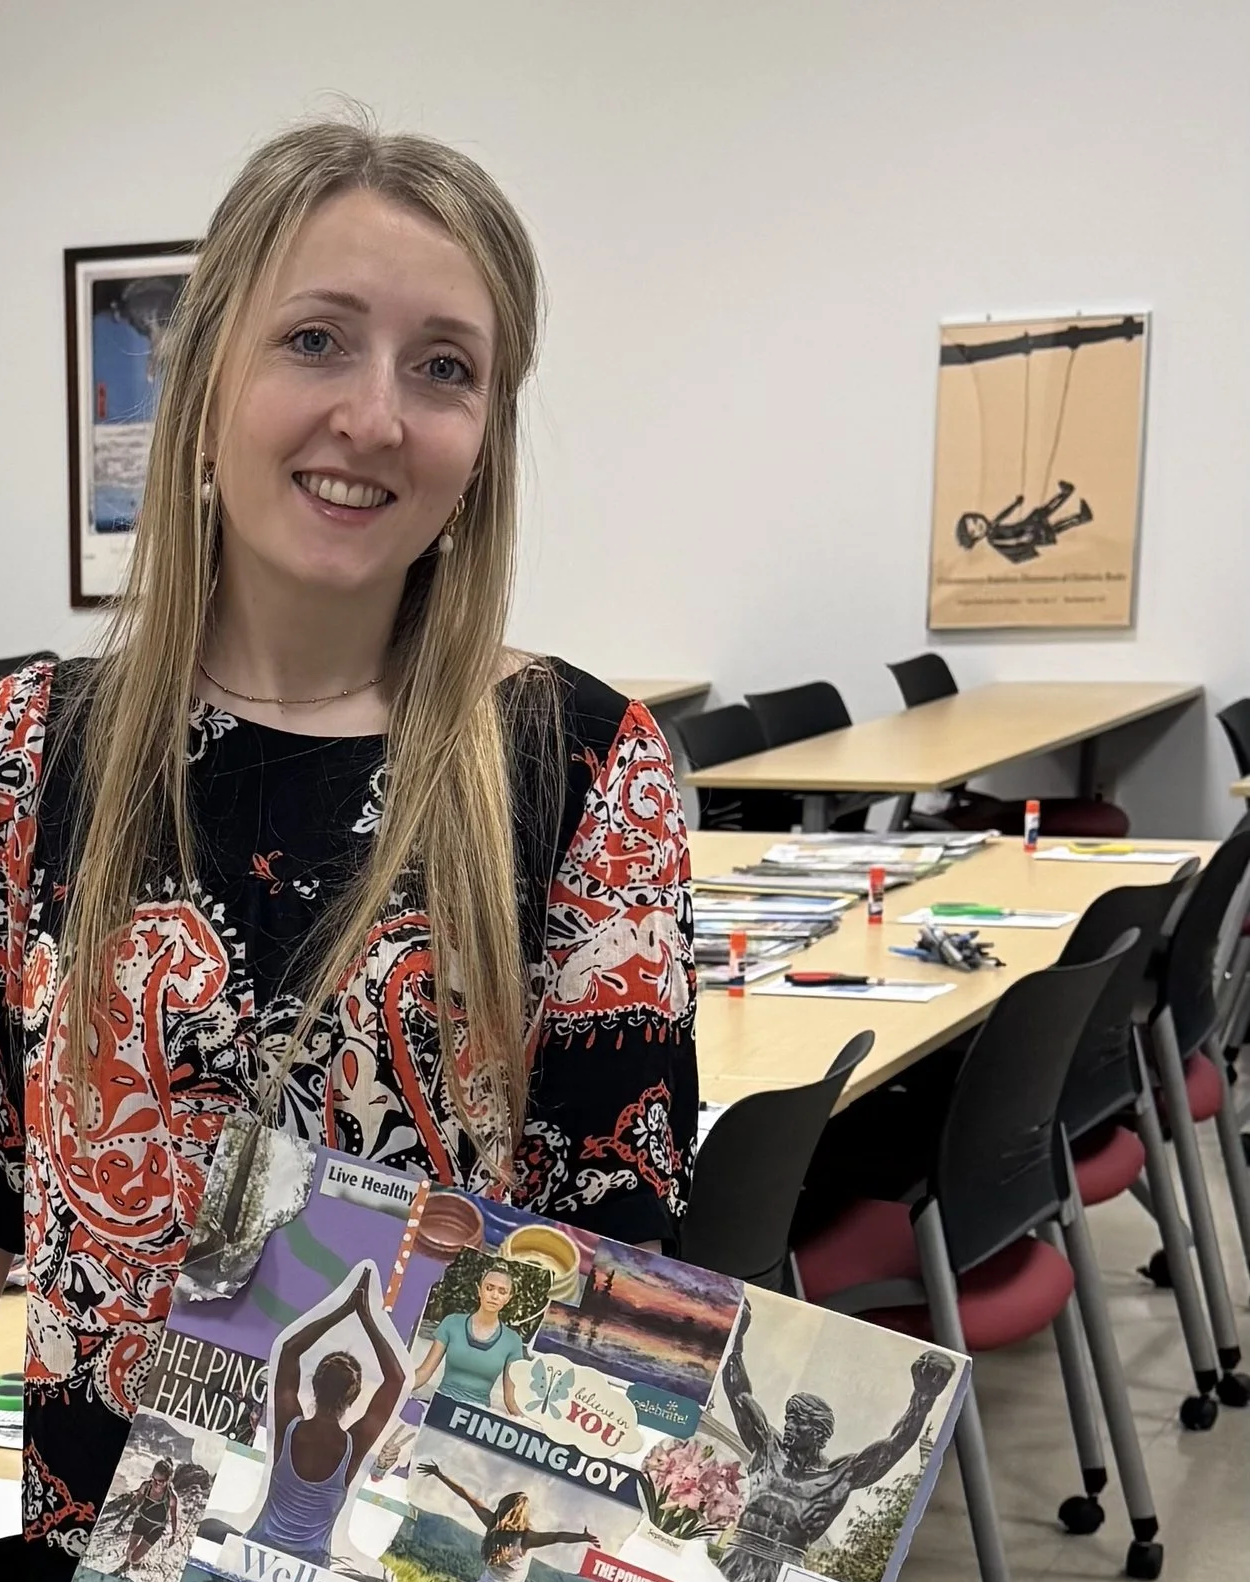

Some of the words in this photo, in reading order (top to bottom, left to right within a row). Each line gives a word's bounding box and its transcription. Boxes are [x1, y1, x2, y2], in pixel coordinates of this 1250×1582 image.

[329, 1165, 358, 1186] Live
[361, 1175, 417, 1206] Healthy
[154, 1330, 268, 1404] HELPING
[153, 1374, 246, 1440] HAND!
[565, 1401, 625, 1447] YOU
[575, 1387, 615, 1420] believe
[616, 1416, 630, 1430] in
[633, 1399, 688, 1425] celebrate!
[449, 1406, 570, 1471] FINDING
[567, 1456, 629, 1493] JOY
[592, 1559, 618, 1579] THE
